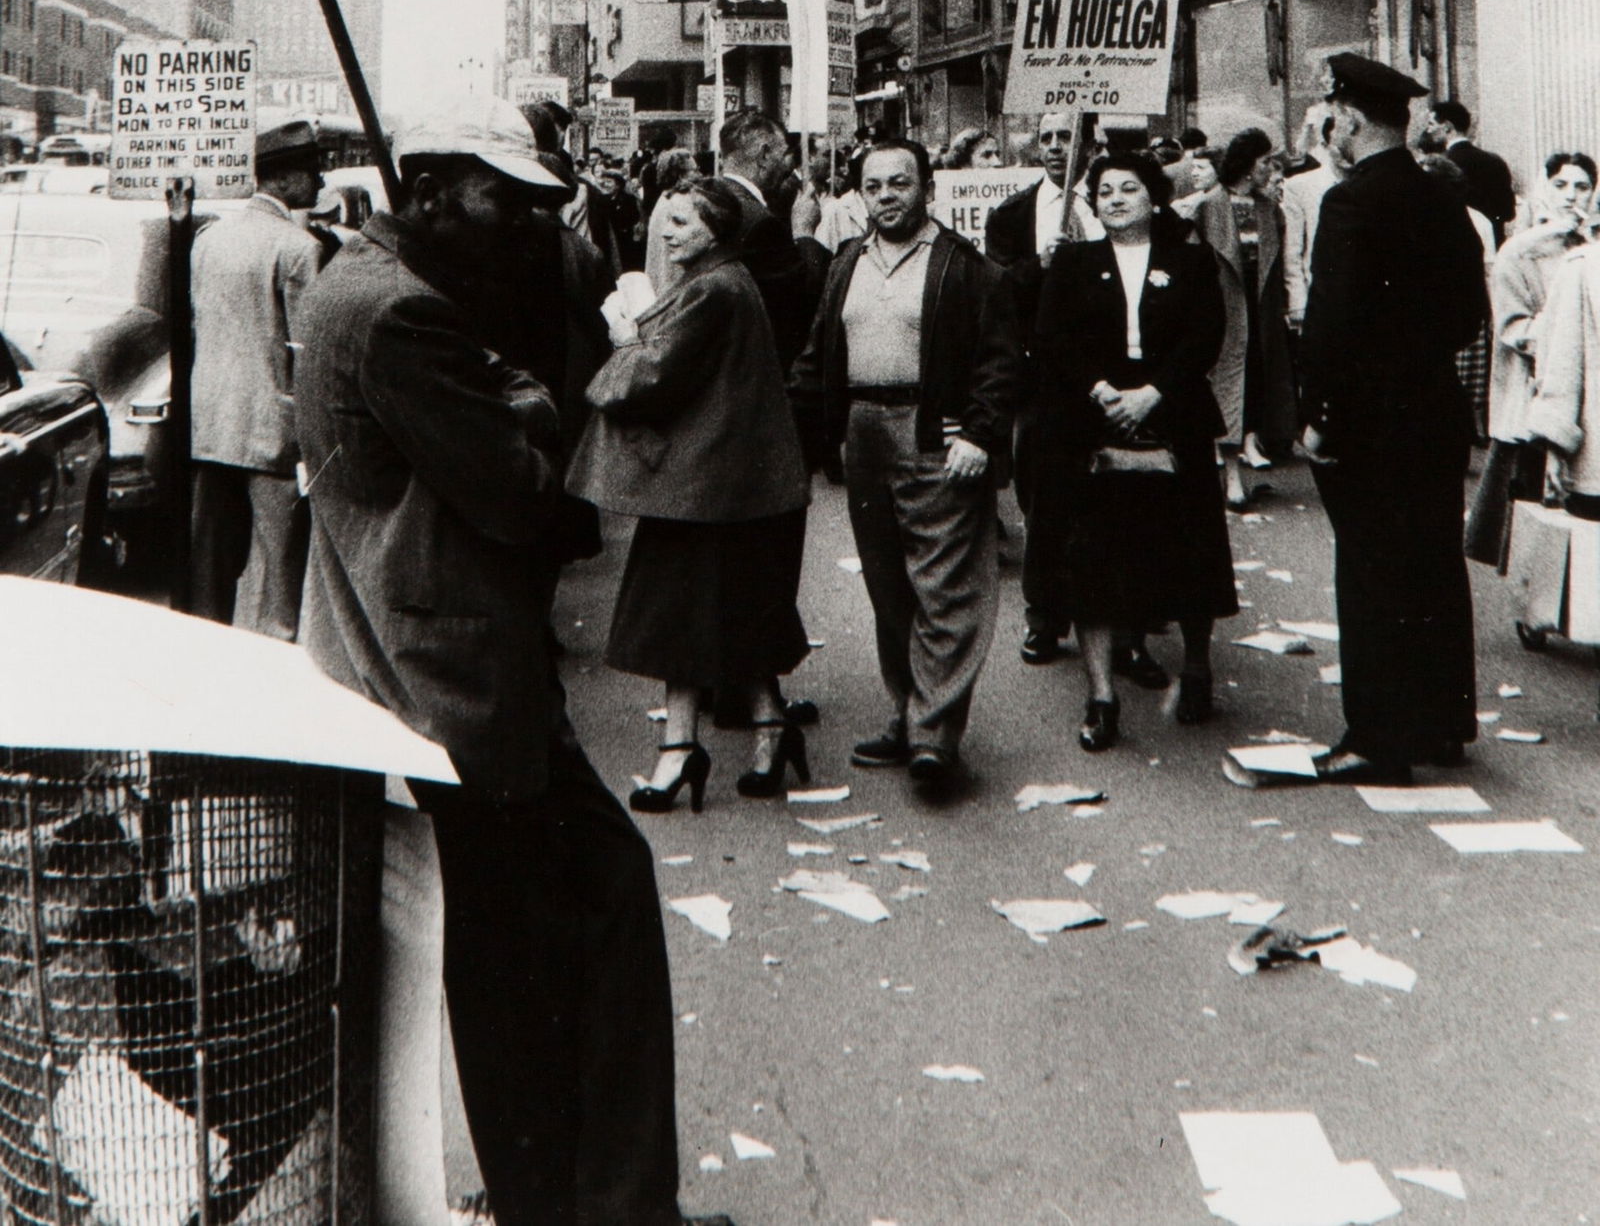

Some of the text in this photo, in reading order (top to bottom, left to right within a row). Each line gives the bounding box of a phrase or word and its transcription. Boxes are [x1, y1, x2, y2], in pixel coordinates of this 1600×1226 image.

[120, 49, 251, 76] NO PARKING
[1023, 53, 1056, 68] Favor
[1074, 53, 1091, 67] No
[1093, 52, 1157, 67] Patrocinar
[123, 76, 246, 94] ON THIS SIDE
[1044, 90, 1076, 106] DPO
[1091, 90, 1120, 106] CIO
[156, 119, 172, 129] TO
[129, 137, 236, 153] PARKING LIMIT
[116, 156, 151, 170] OTHER
[193, 155, 215, 168] ONE
[218, 154, 249, 168] HOUR
[952, 183, 1019, 199] EMPLOYEES
[952, 207, 995, 232] HE
